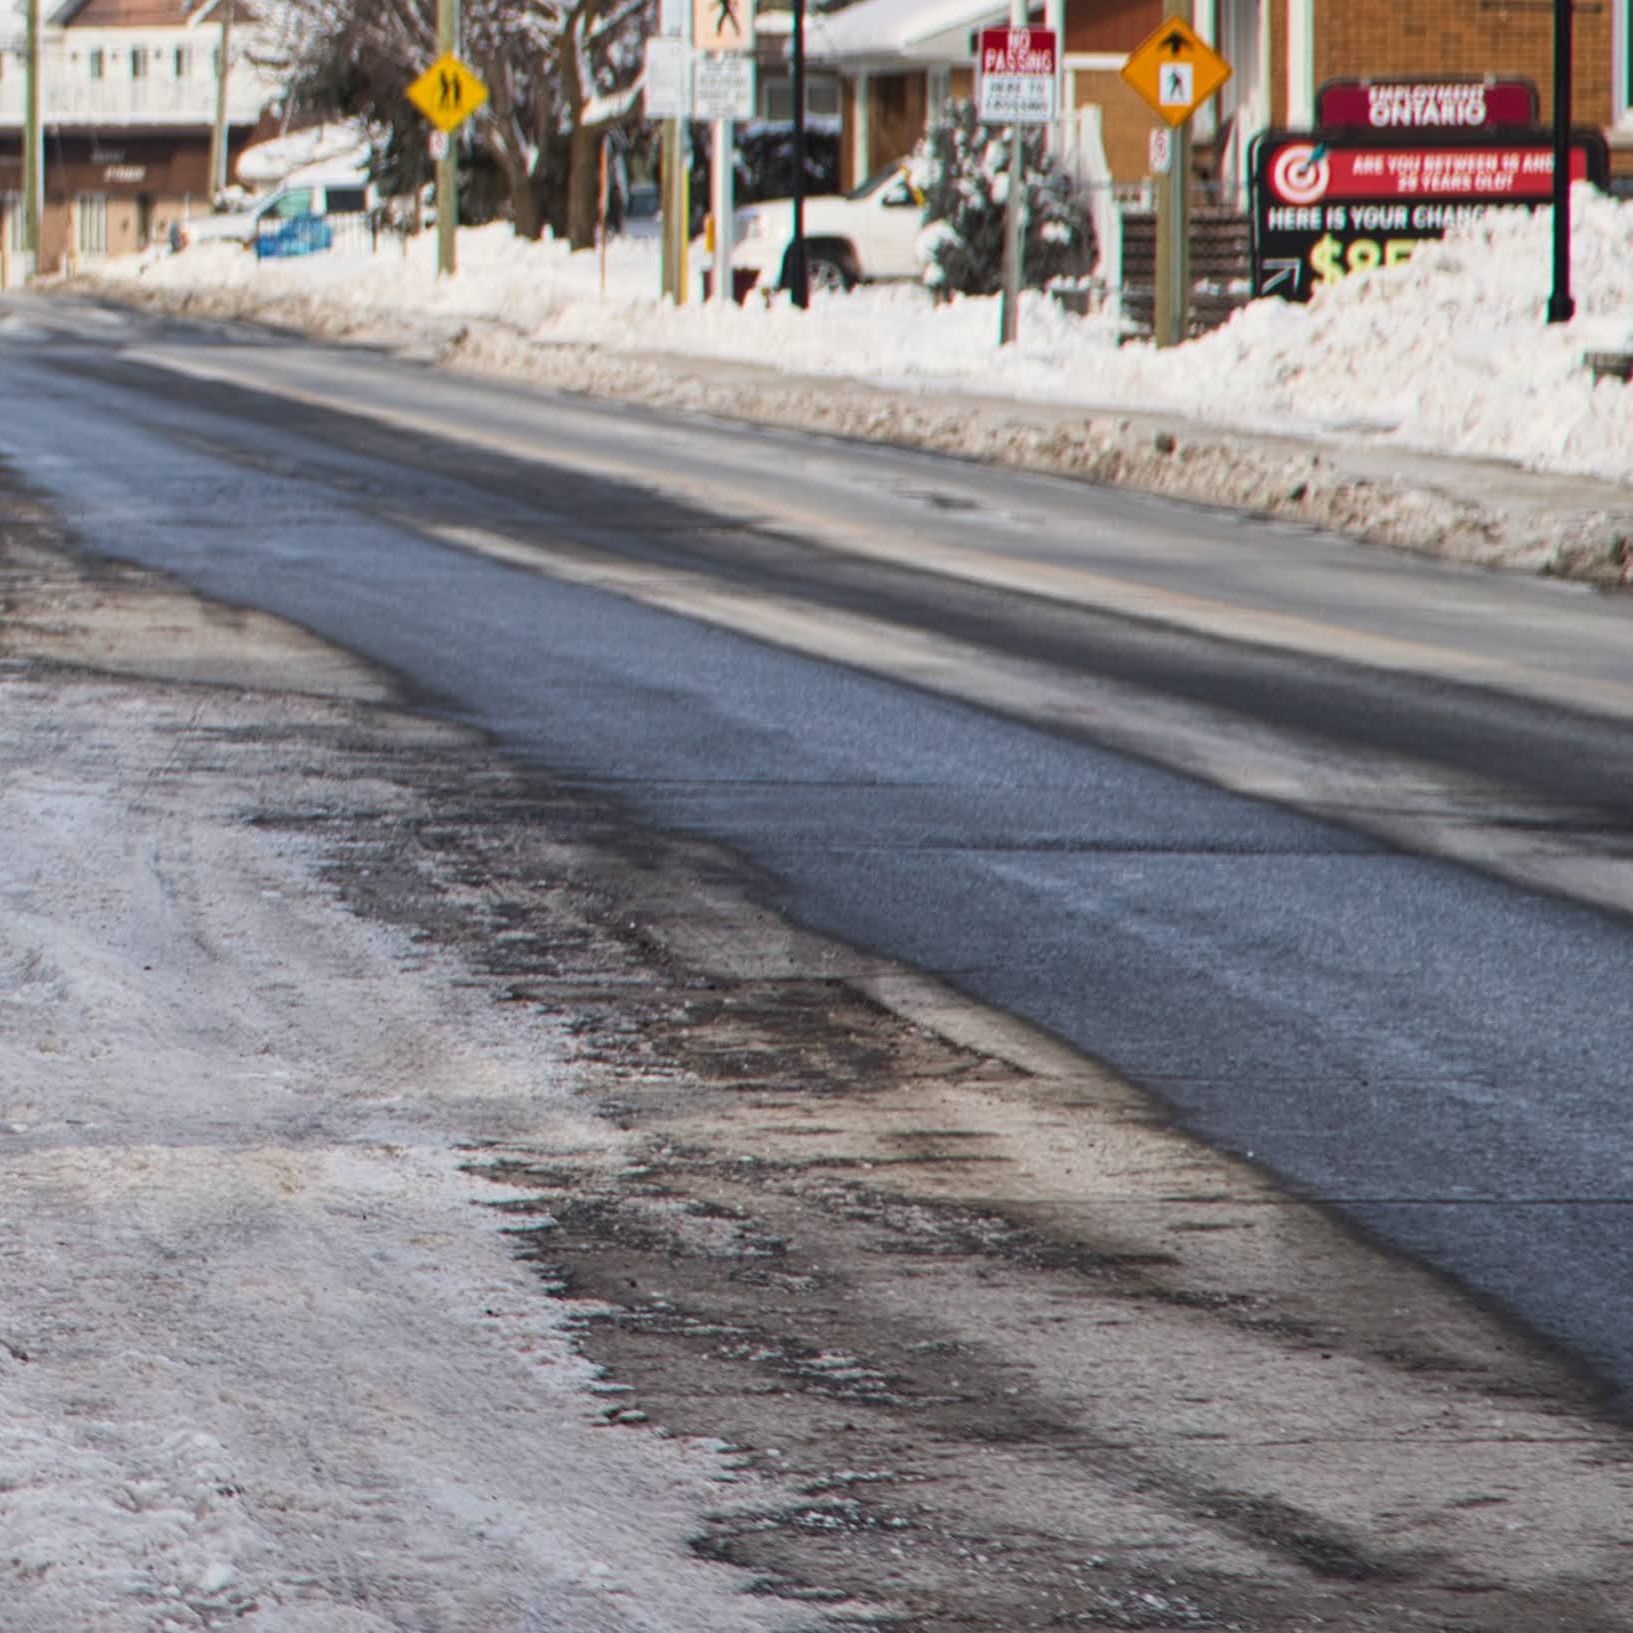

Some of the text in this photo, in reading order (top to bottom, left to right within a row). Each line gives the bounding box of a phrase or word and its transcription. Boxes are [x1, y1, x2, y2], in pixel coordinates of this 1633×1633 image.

[1007, 28, 1031, 50] NO
[984, 48, 1053, 73] PASSING
[1368, 84, 1486, 102] EMPLOYMENT
[1369, 102, 1487, 126] ONTARIO
[1353, 154, 1383, 176] ARE
[1387, 154, 1421, 176] YOU
[1424, 153, 1499, 175] BETWEEN
[1421, 173, 1472, 192] YEARS
[1475, 172, 1514, 192] OLD?
[1268, 206, 1322, 231] HERE
[1326, 206, 1347, 230] IS
[1349, 205, 1409, 230] YOUR
